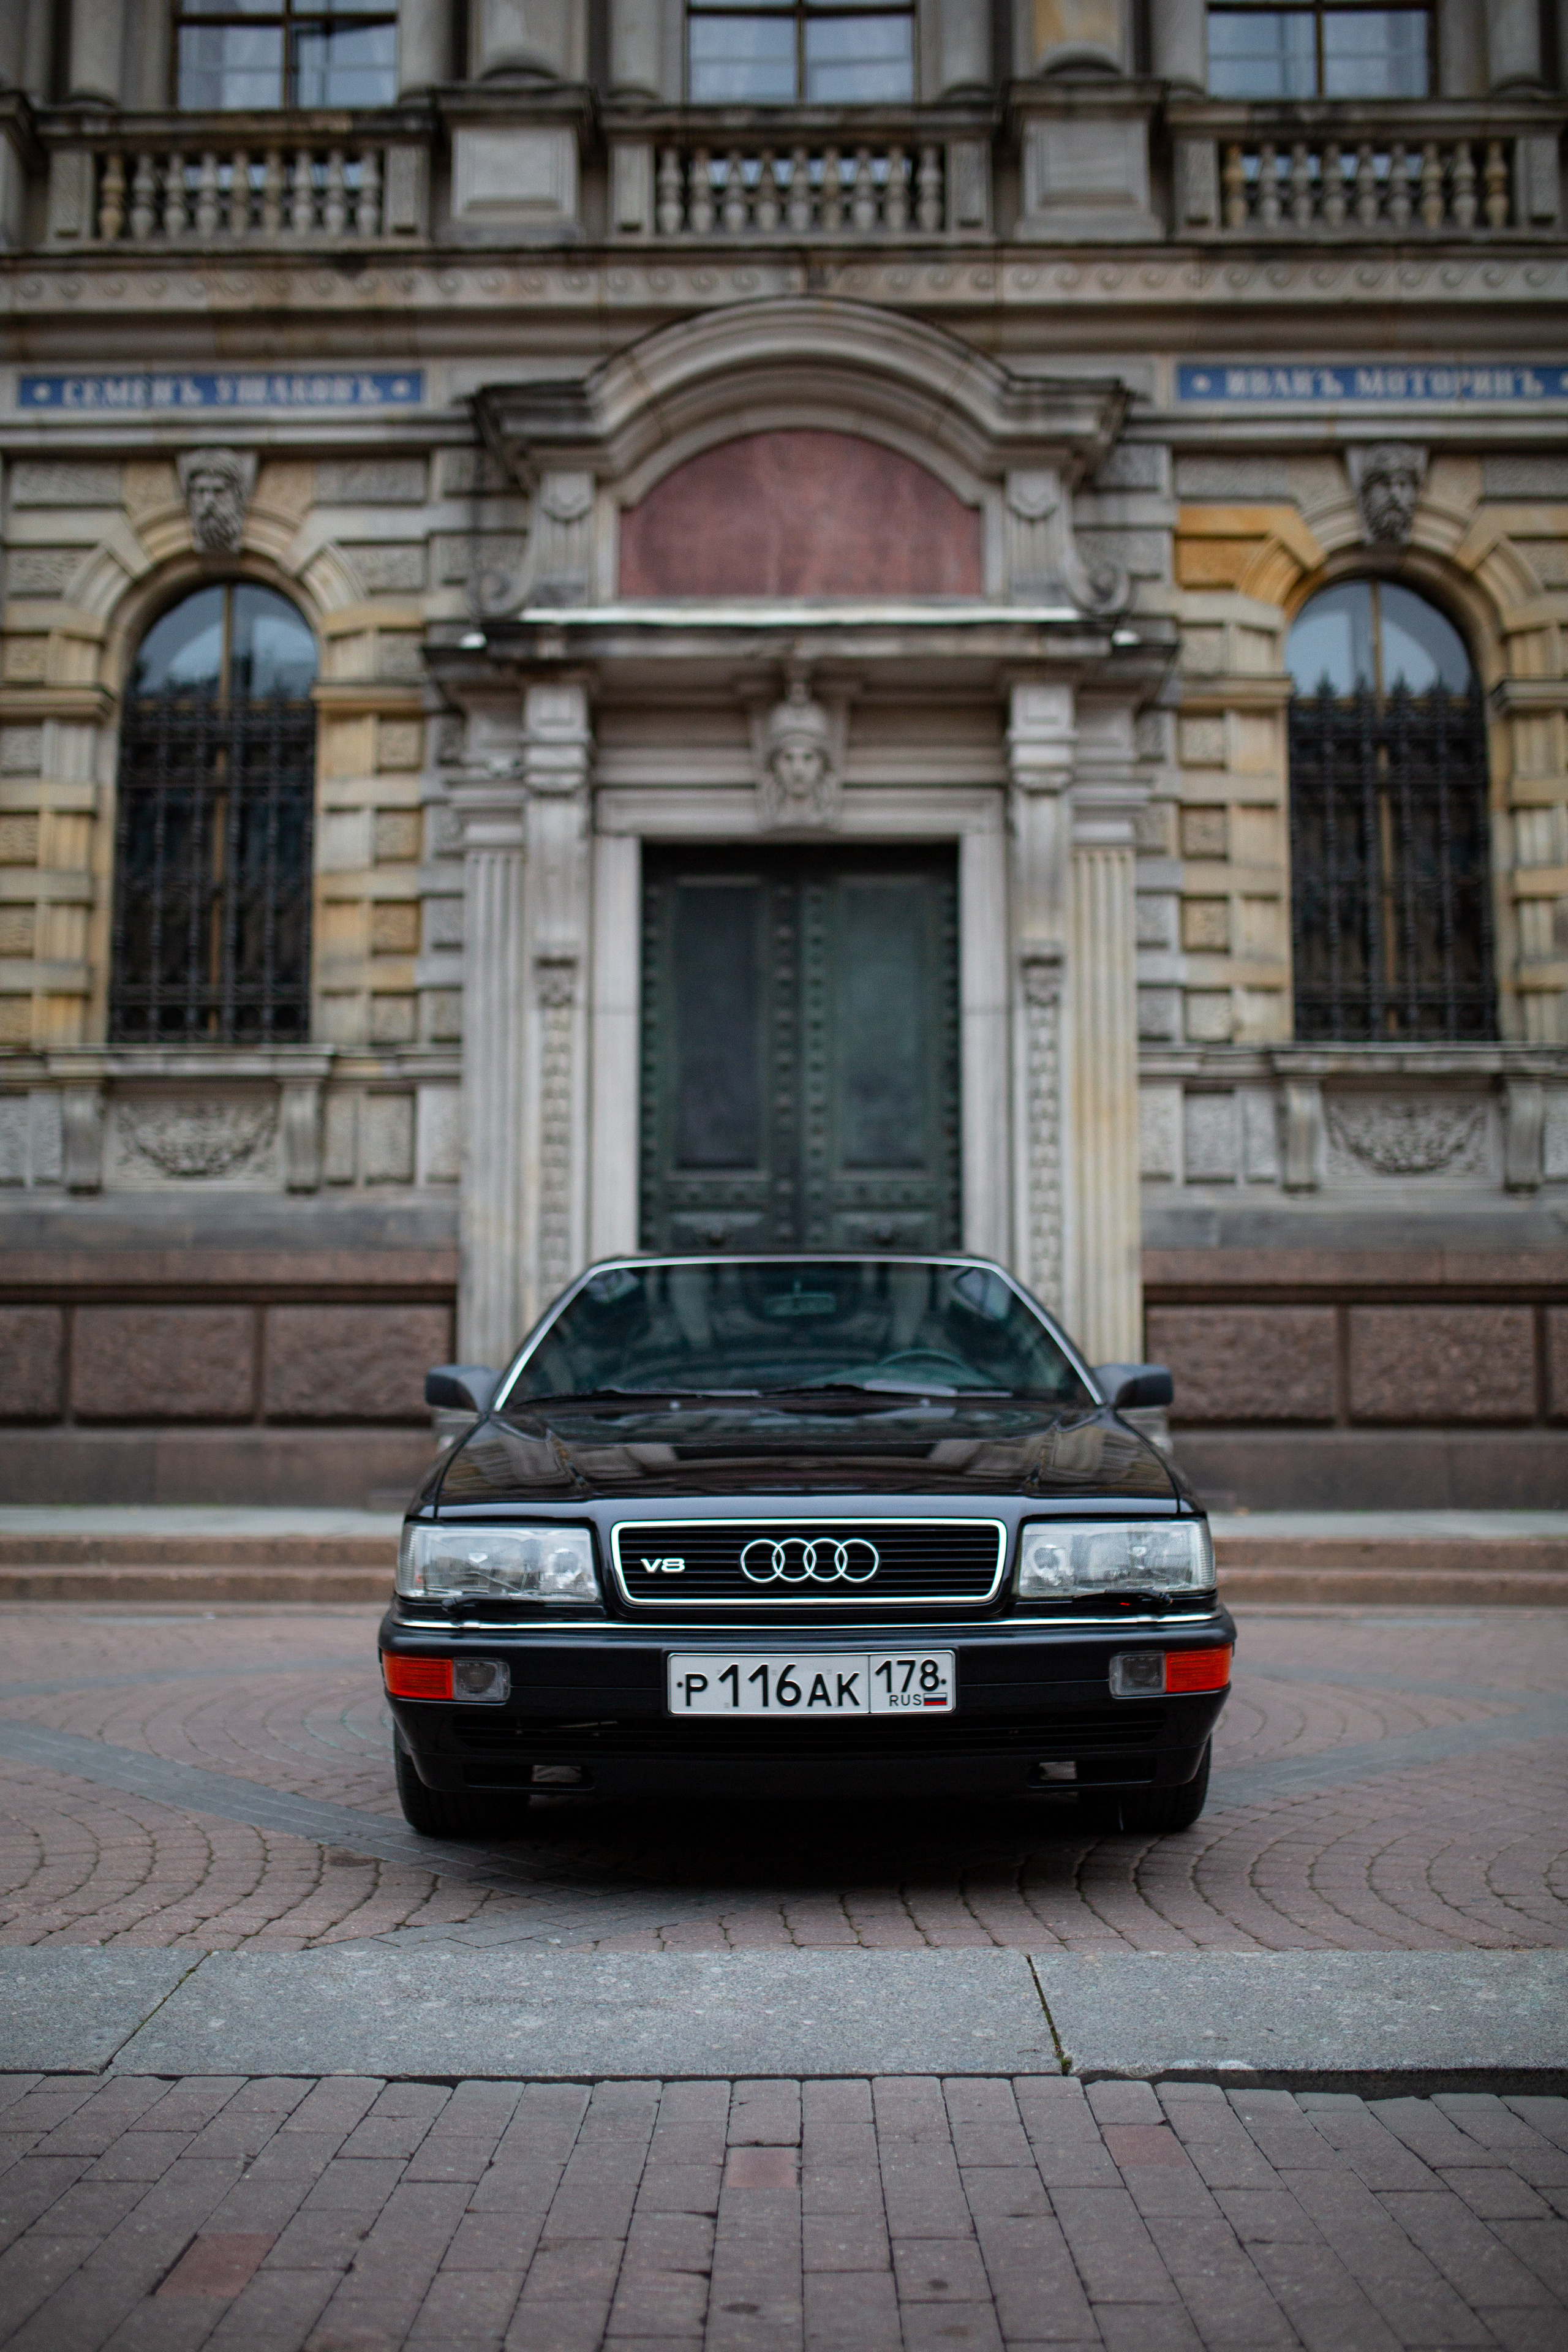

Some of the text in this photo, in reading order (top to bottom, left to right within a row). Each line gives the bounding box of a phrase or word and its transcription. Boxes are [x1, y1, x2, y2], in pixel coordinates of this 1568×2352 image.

[640, 1558, 685, 1573] V8
[874, 1659, 940, 1693] 178
[889, 1694, 922, 1707] RUS
